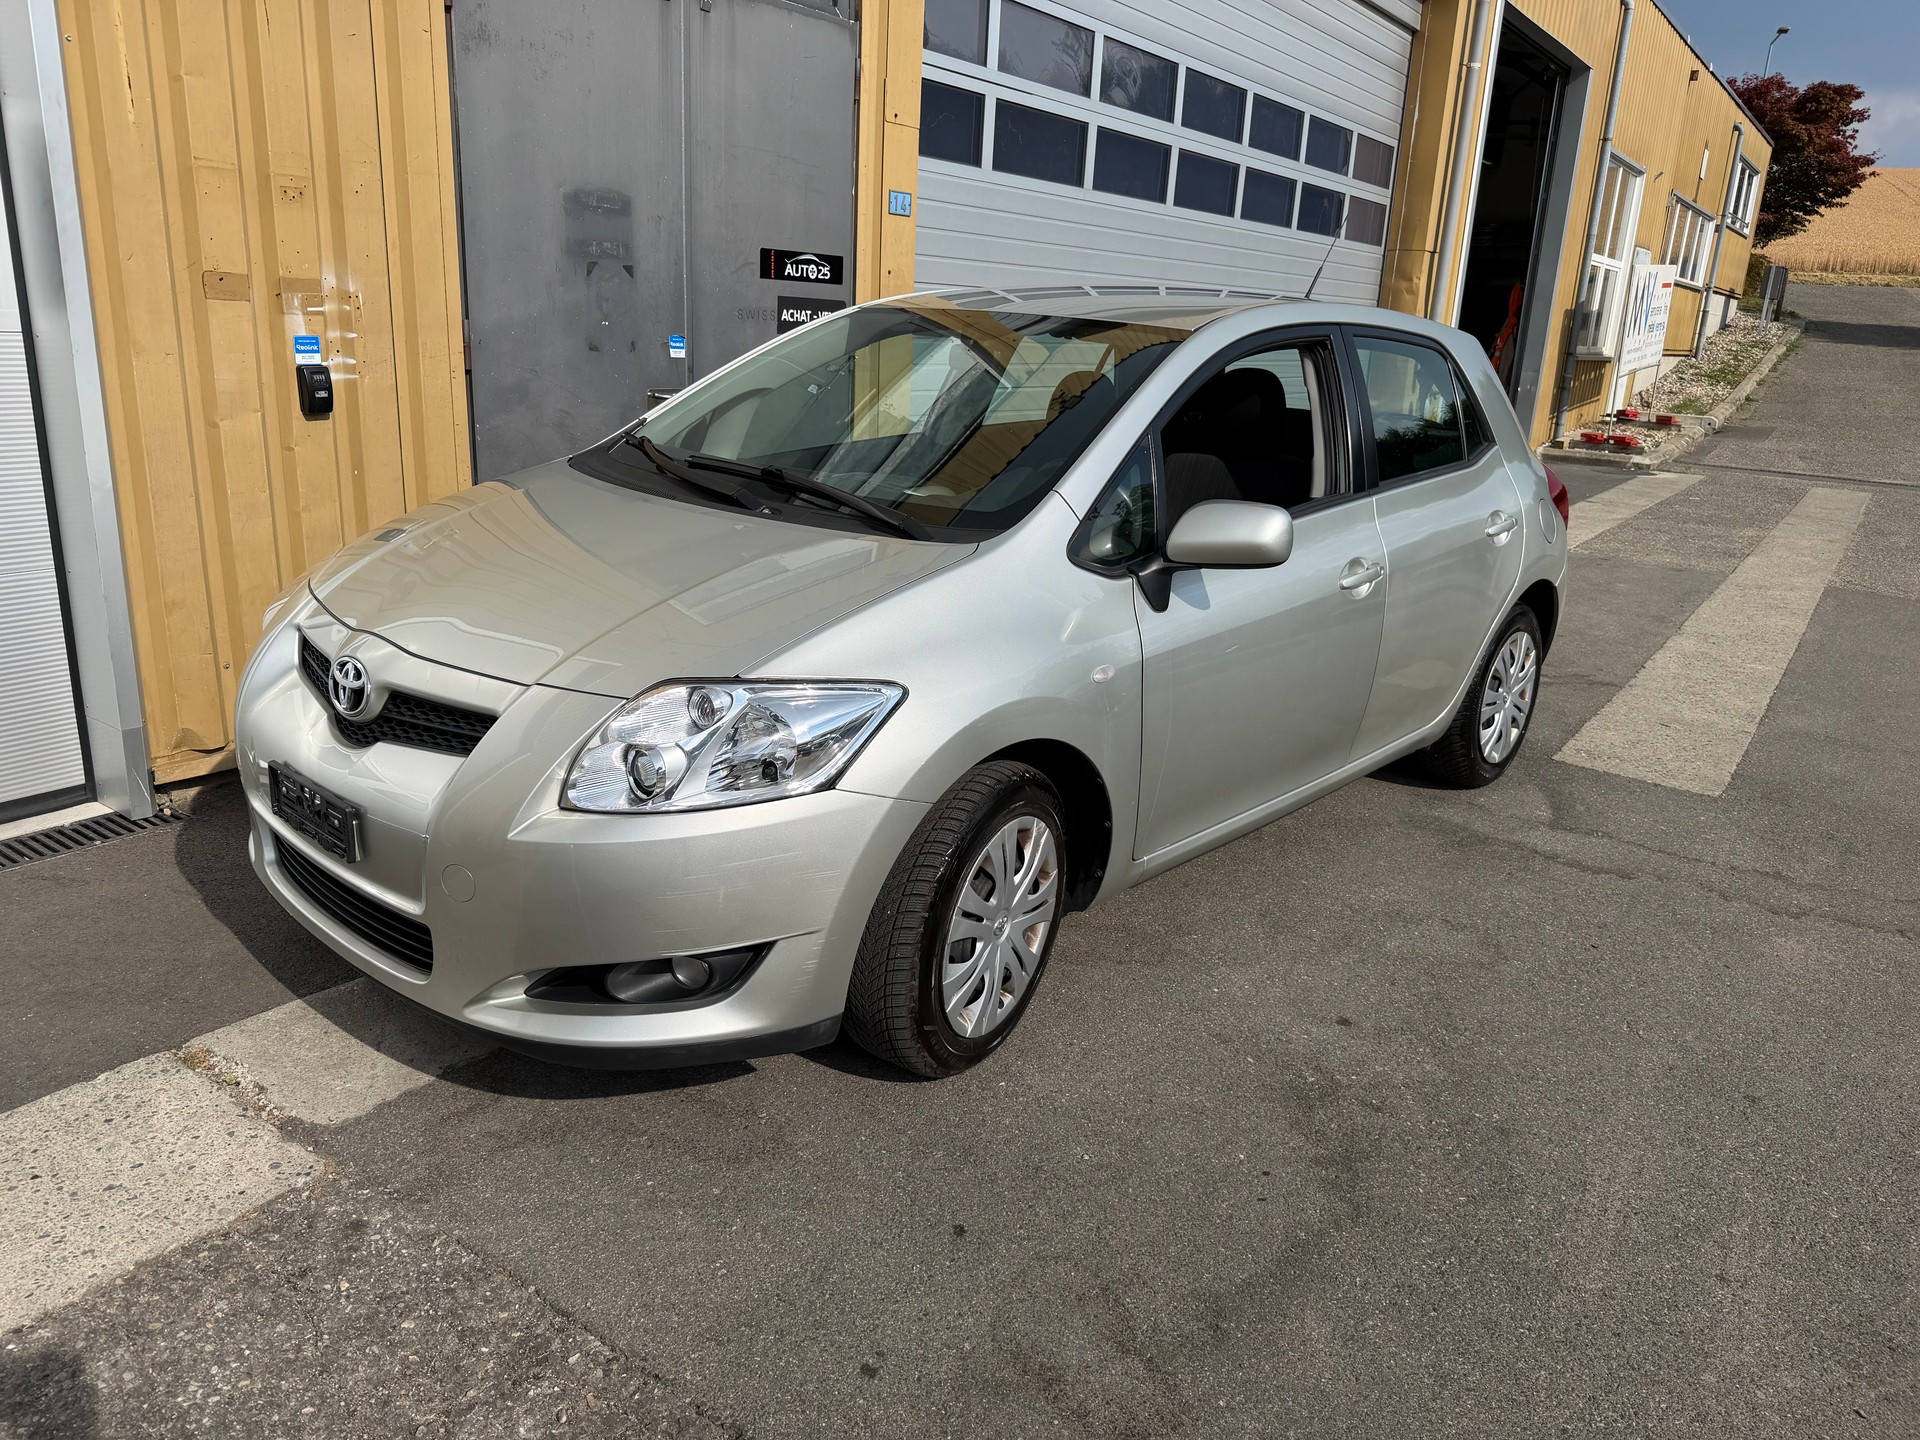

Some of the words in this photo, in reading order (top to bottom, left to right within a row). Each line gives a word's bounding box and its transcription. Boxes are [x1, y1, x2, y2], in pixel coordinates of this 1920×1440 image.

[893, 194, 907, 213] 14
[737, 308, 776, 322] SWISS
[781, 308, 812, 323] ACHAT
